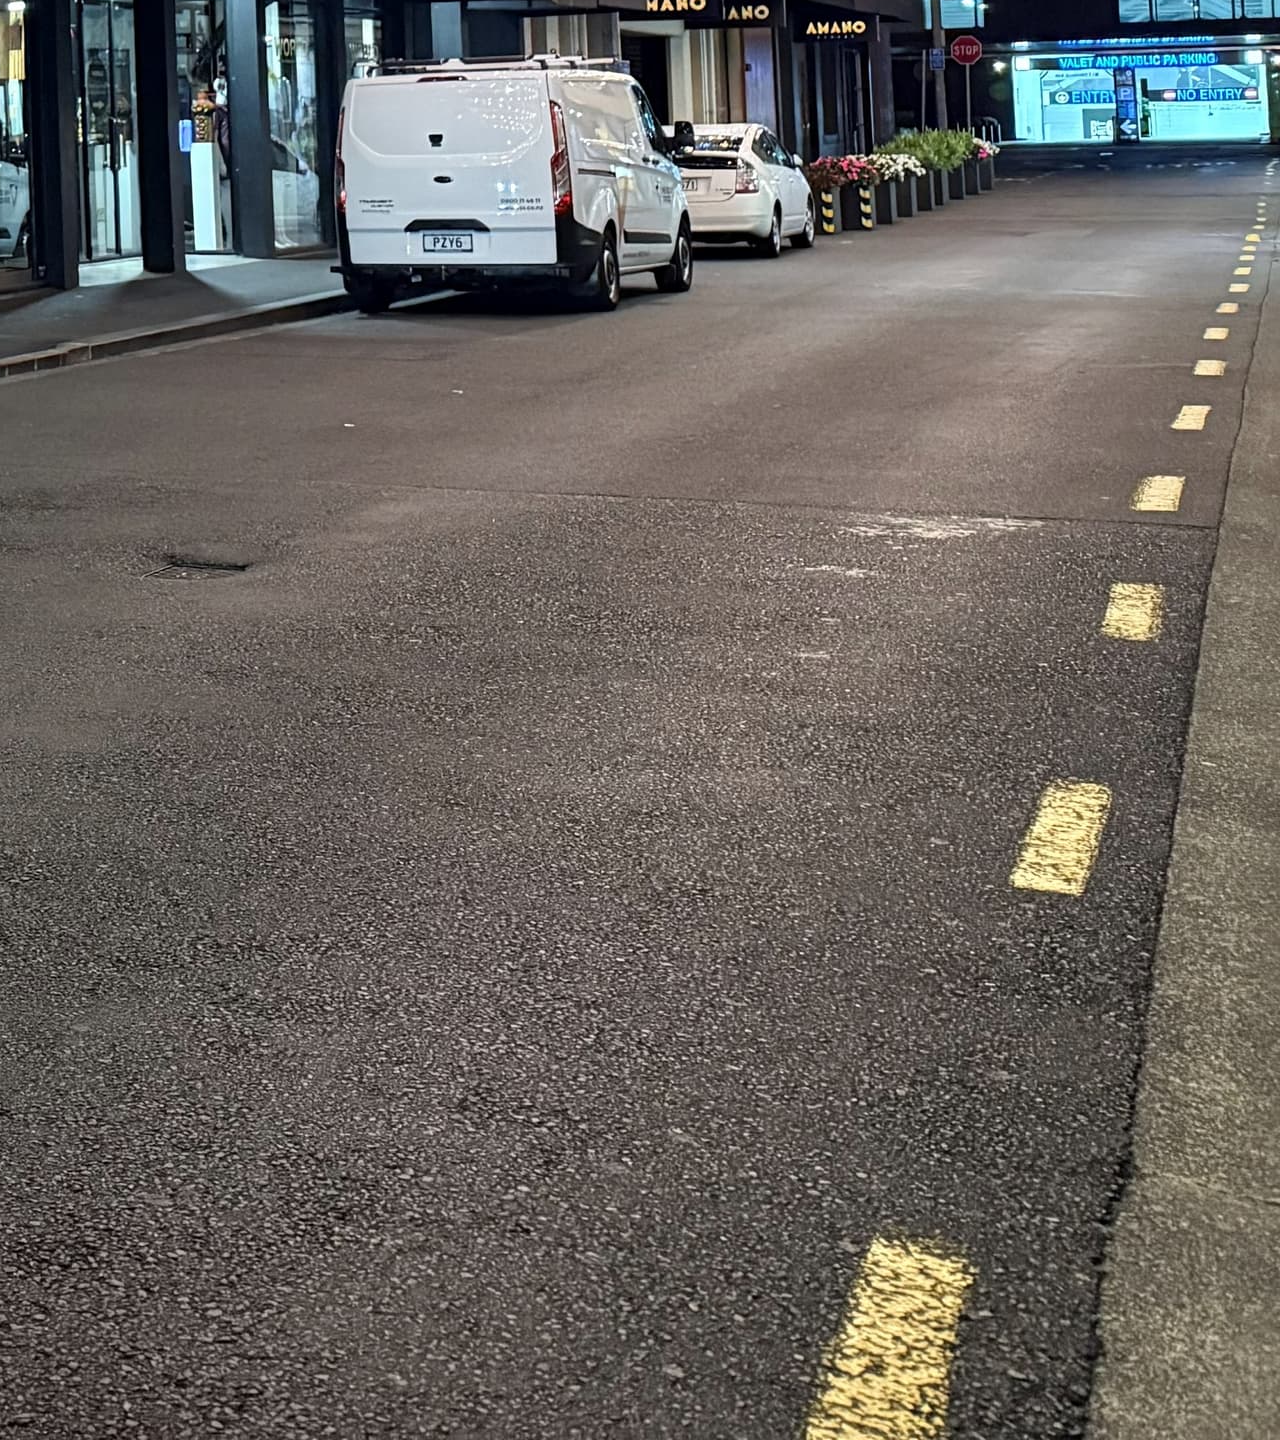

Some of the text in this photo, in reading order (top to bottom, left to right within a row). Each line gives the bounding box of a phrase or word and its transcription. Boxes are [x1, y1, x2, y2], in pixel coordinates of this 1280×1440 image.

[805, 20, 866, 35] AMANO
[953, 45, 979, 56] STOP
[1059, 53, 1216, 68] VALET AND PUBLIC PARKING
[1071, 91, 1116, 103] ENTRY
[1177, 88, 1243, 100] NO ENTRY
[433, 236, 463, 249] PZY6
